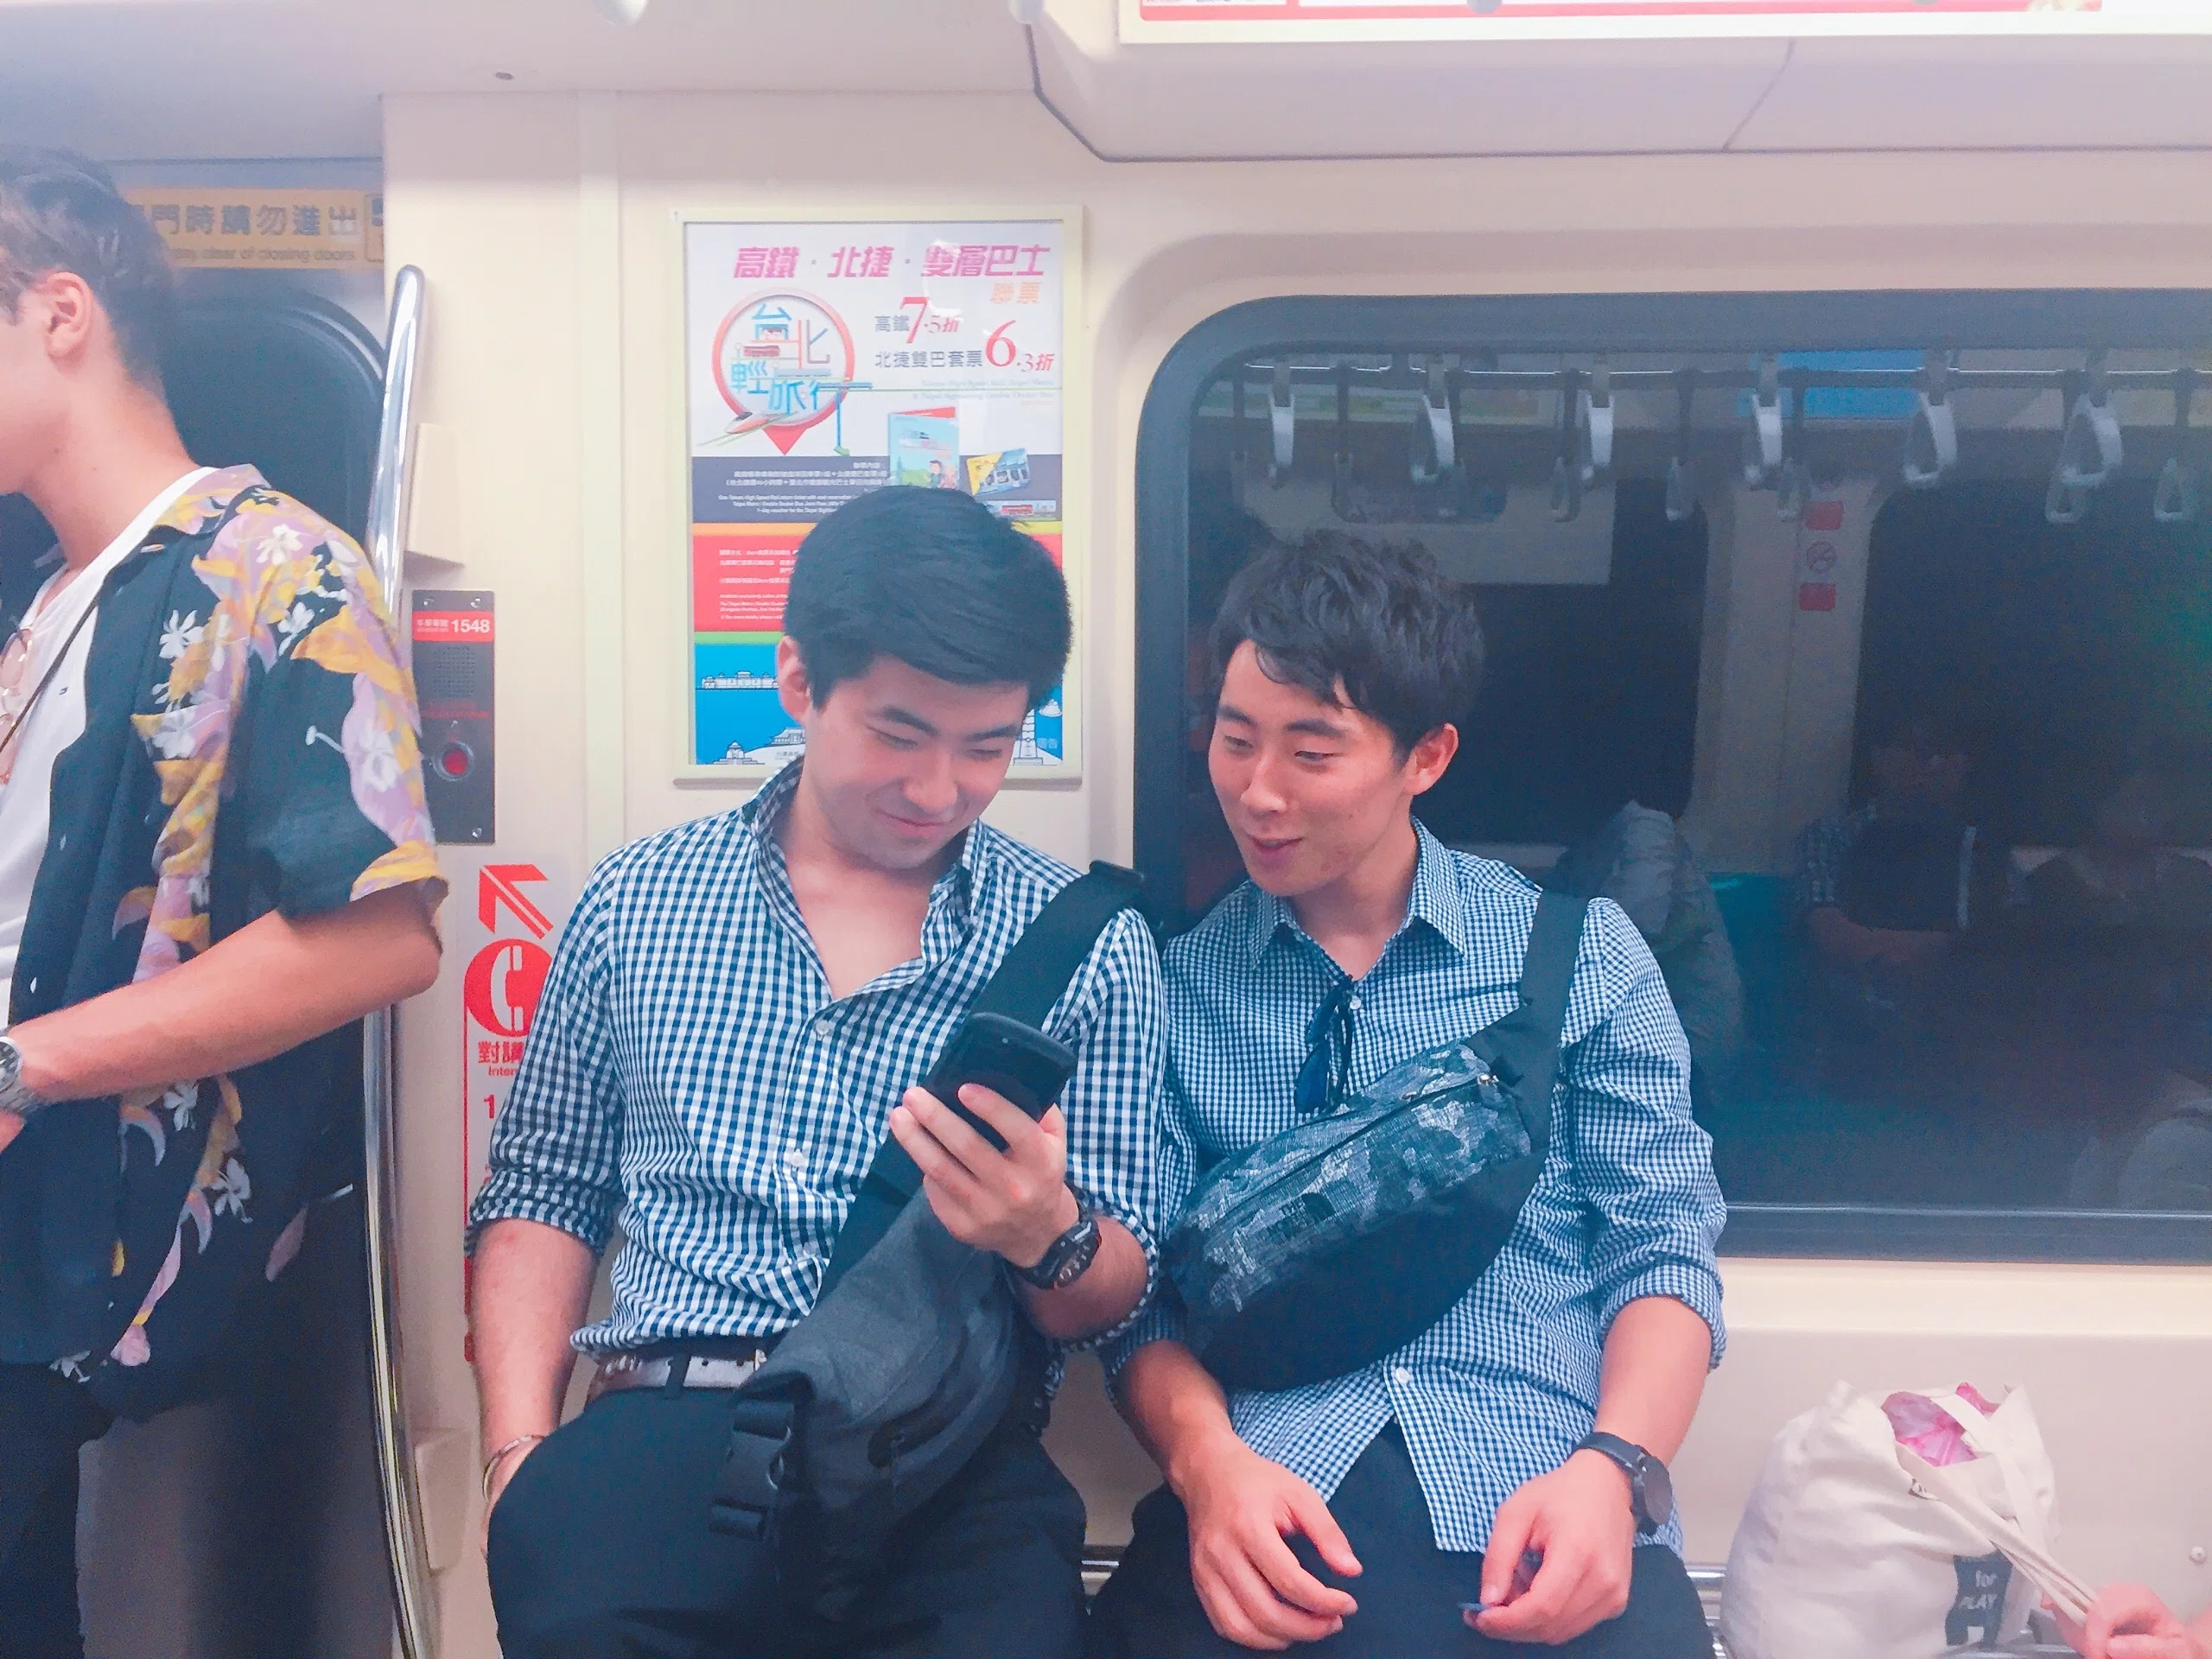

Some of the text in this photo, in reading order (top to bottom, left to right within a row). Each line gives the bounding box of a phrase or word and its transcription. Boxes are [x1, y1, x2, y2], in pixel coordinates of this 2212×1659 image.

[734, 244, 1051, 278] 高鐵 北捷 雙層巴士
[451, 619, 491, 633] 1548
[483, 1094, 495, 1119] 1
